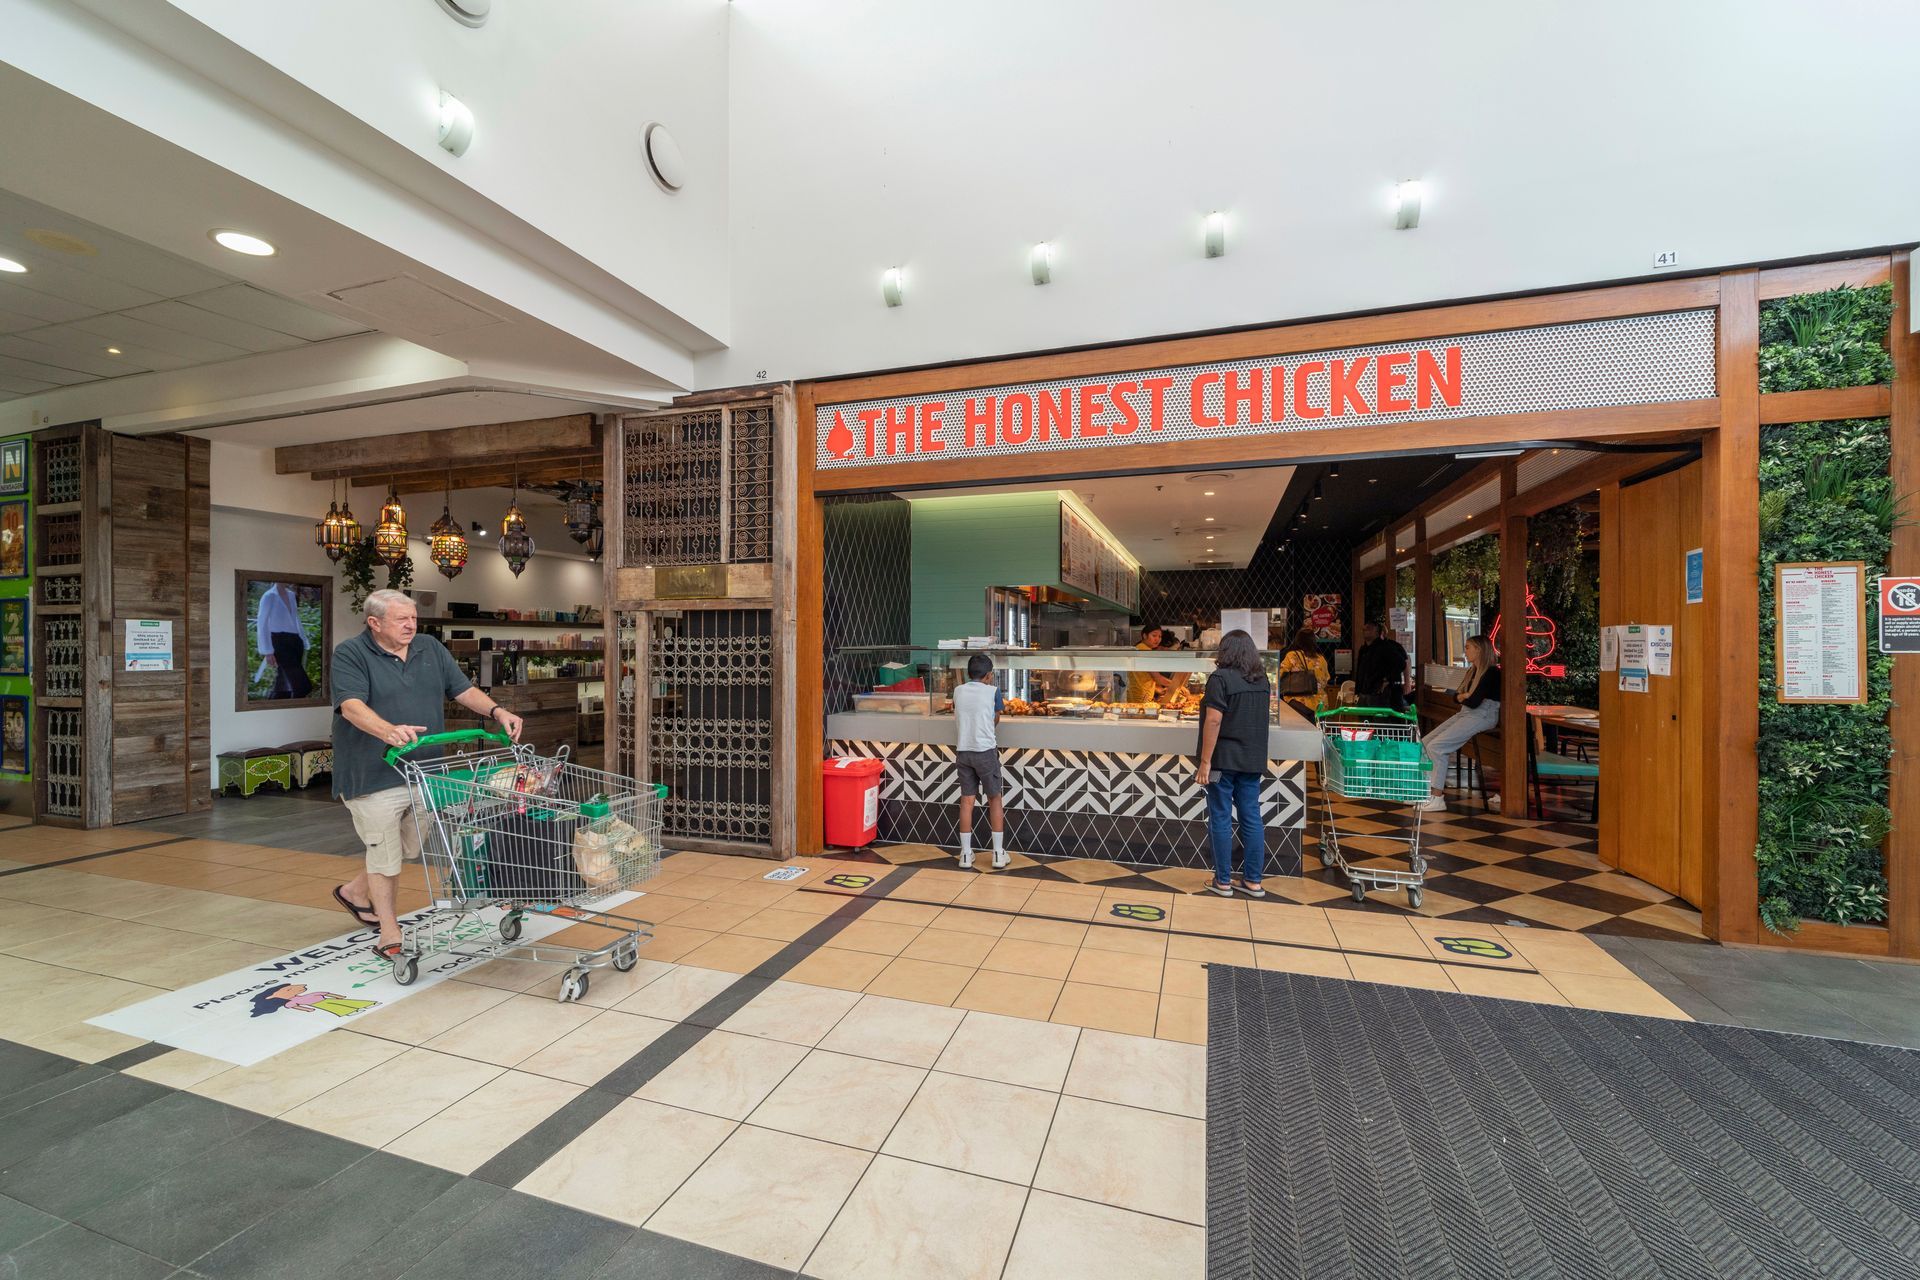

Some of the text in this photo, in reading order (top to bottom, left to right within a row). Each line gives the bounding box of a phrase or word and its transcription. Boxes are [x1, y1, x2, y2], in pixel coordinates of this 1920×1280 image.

[1658, 252, 1675, 263] 41
[756, 370, 767, 379] 42
[858, 346, 1462, 458] THE HONEST CHICKEN
[1896, 593, 1916, 607] 18
[192, 978, 280, 1010] Please
